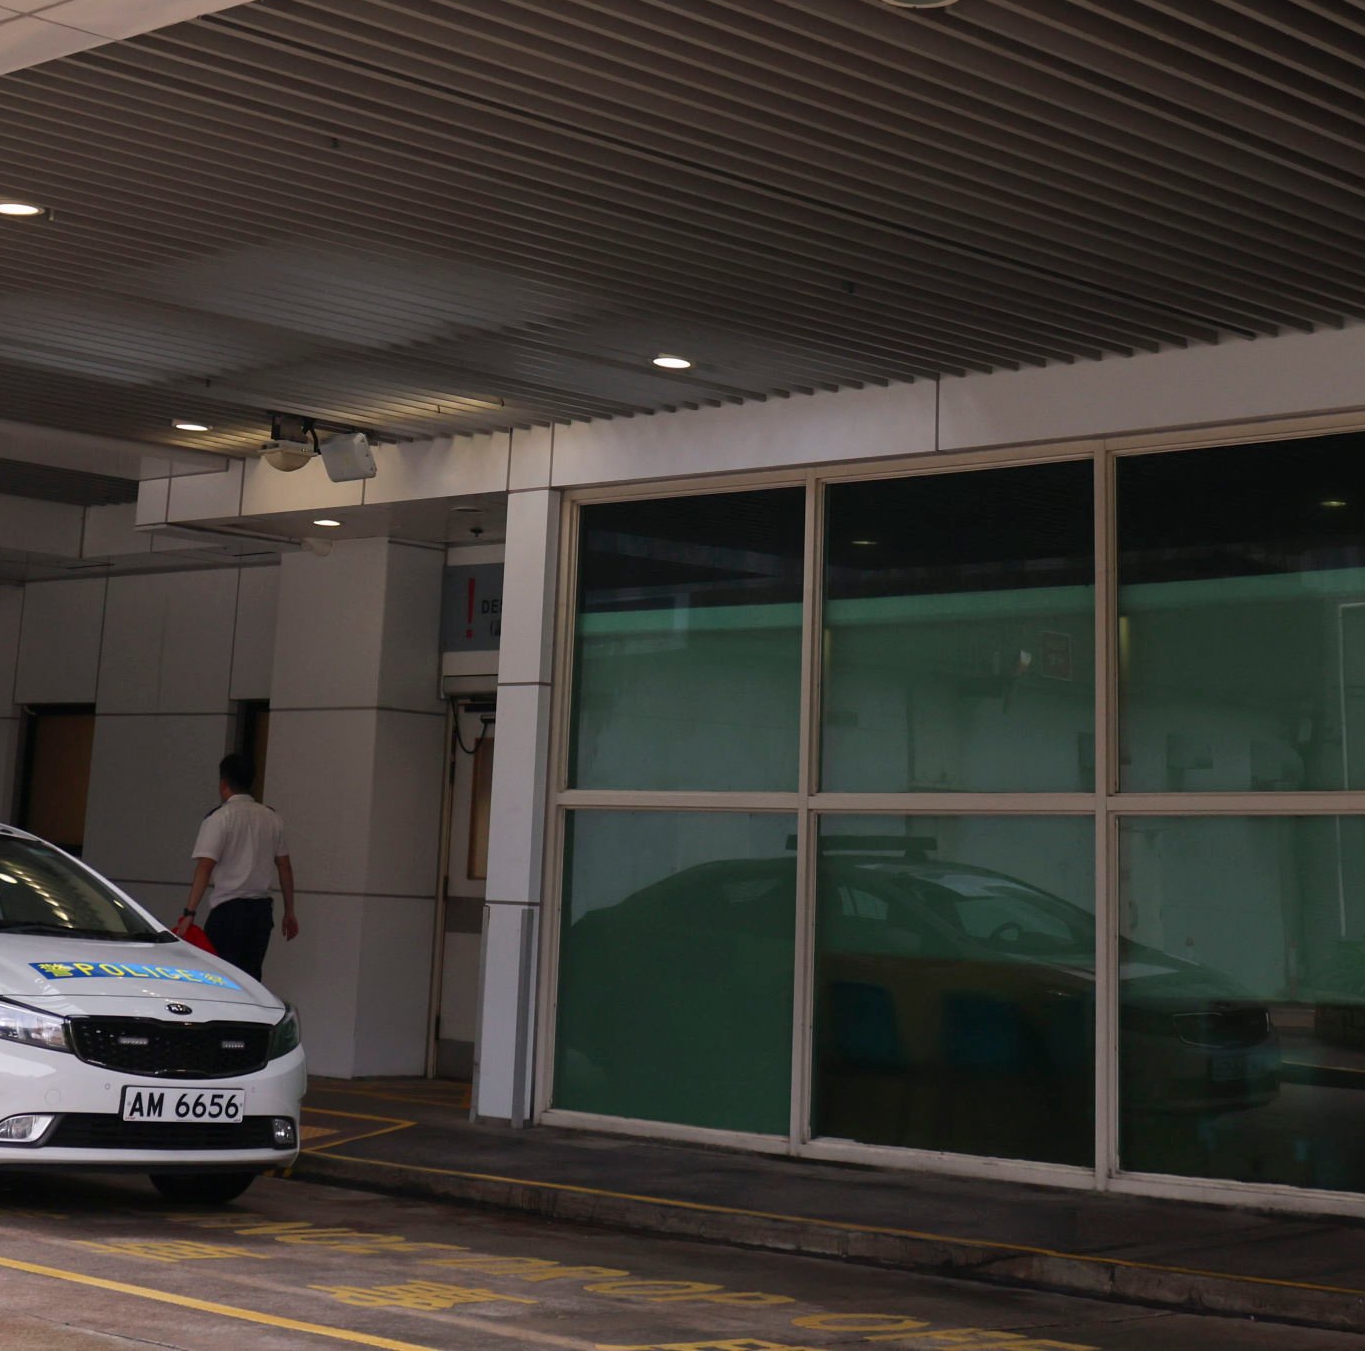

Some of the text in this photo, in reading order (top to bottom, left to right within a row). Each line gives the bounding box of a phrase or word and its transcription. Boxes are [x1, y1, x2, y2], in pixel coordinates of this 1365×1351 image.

[73, 963, 203, 983] POLICE
[129, 1093, 239, 1119] AM 6656
[420, 1257, 697, 1305] DROP
